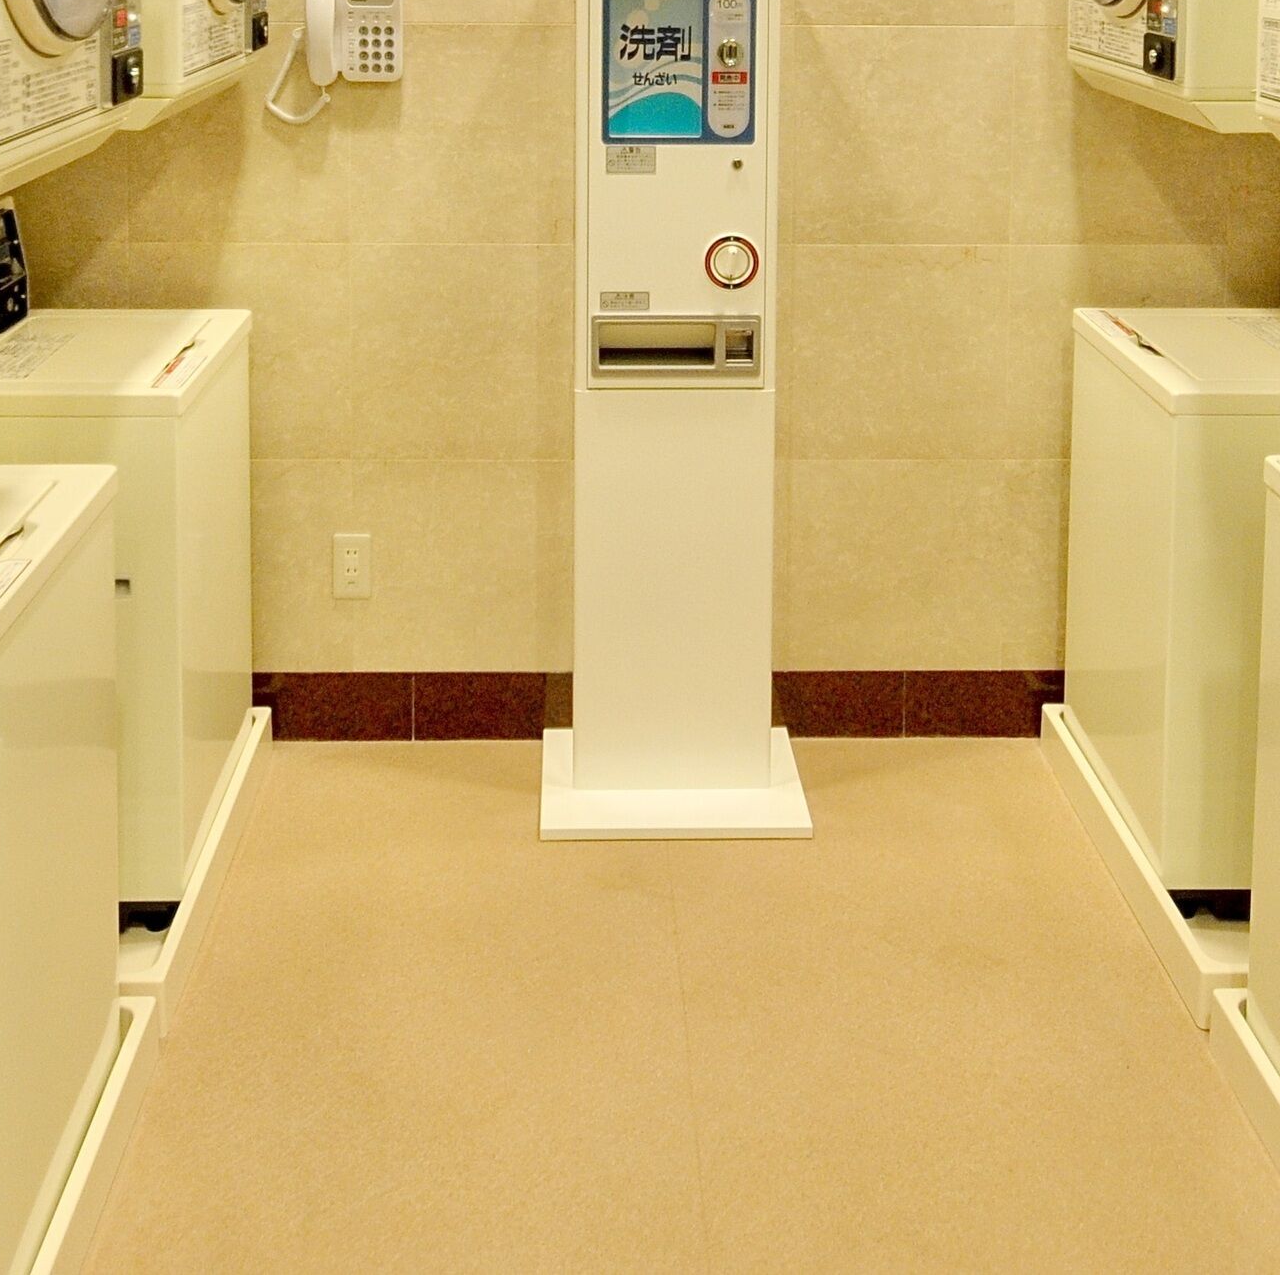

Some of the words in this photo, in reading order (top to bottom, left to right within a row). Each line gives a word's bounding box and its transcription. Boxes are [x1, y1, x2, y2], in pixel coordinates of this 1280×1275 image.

[619, 22, 693, 63] 洗剤
[631, 70, 679, 88] せんざい
